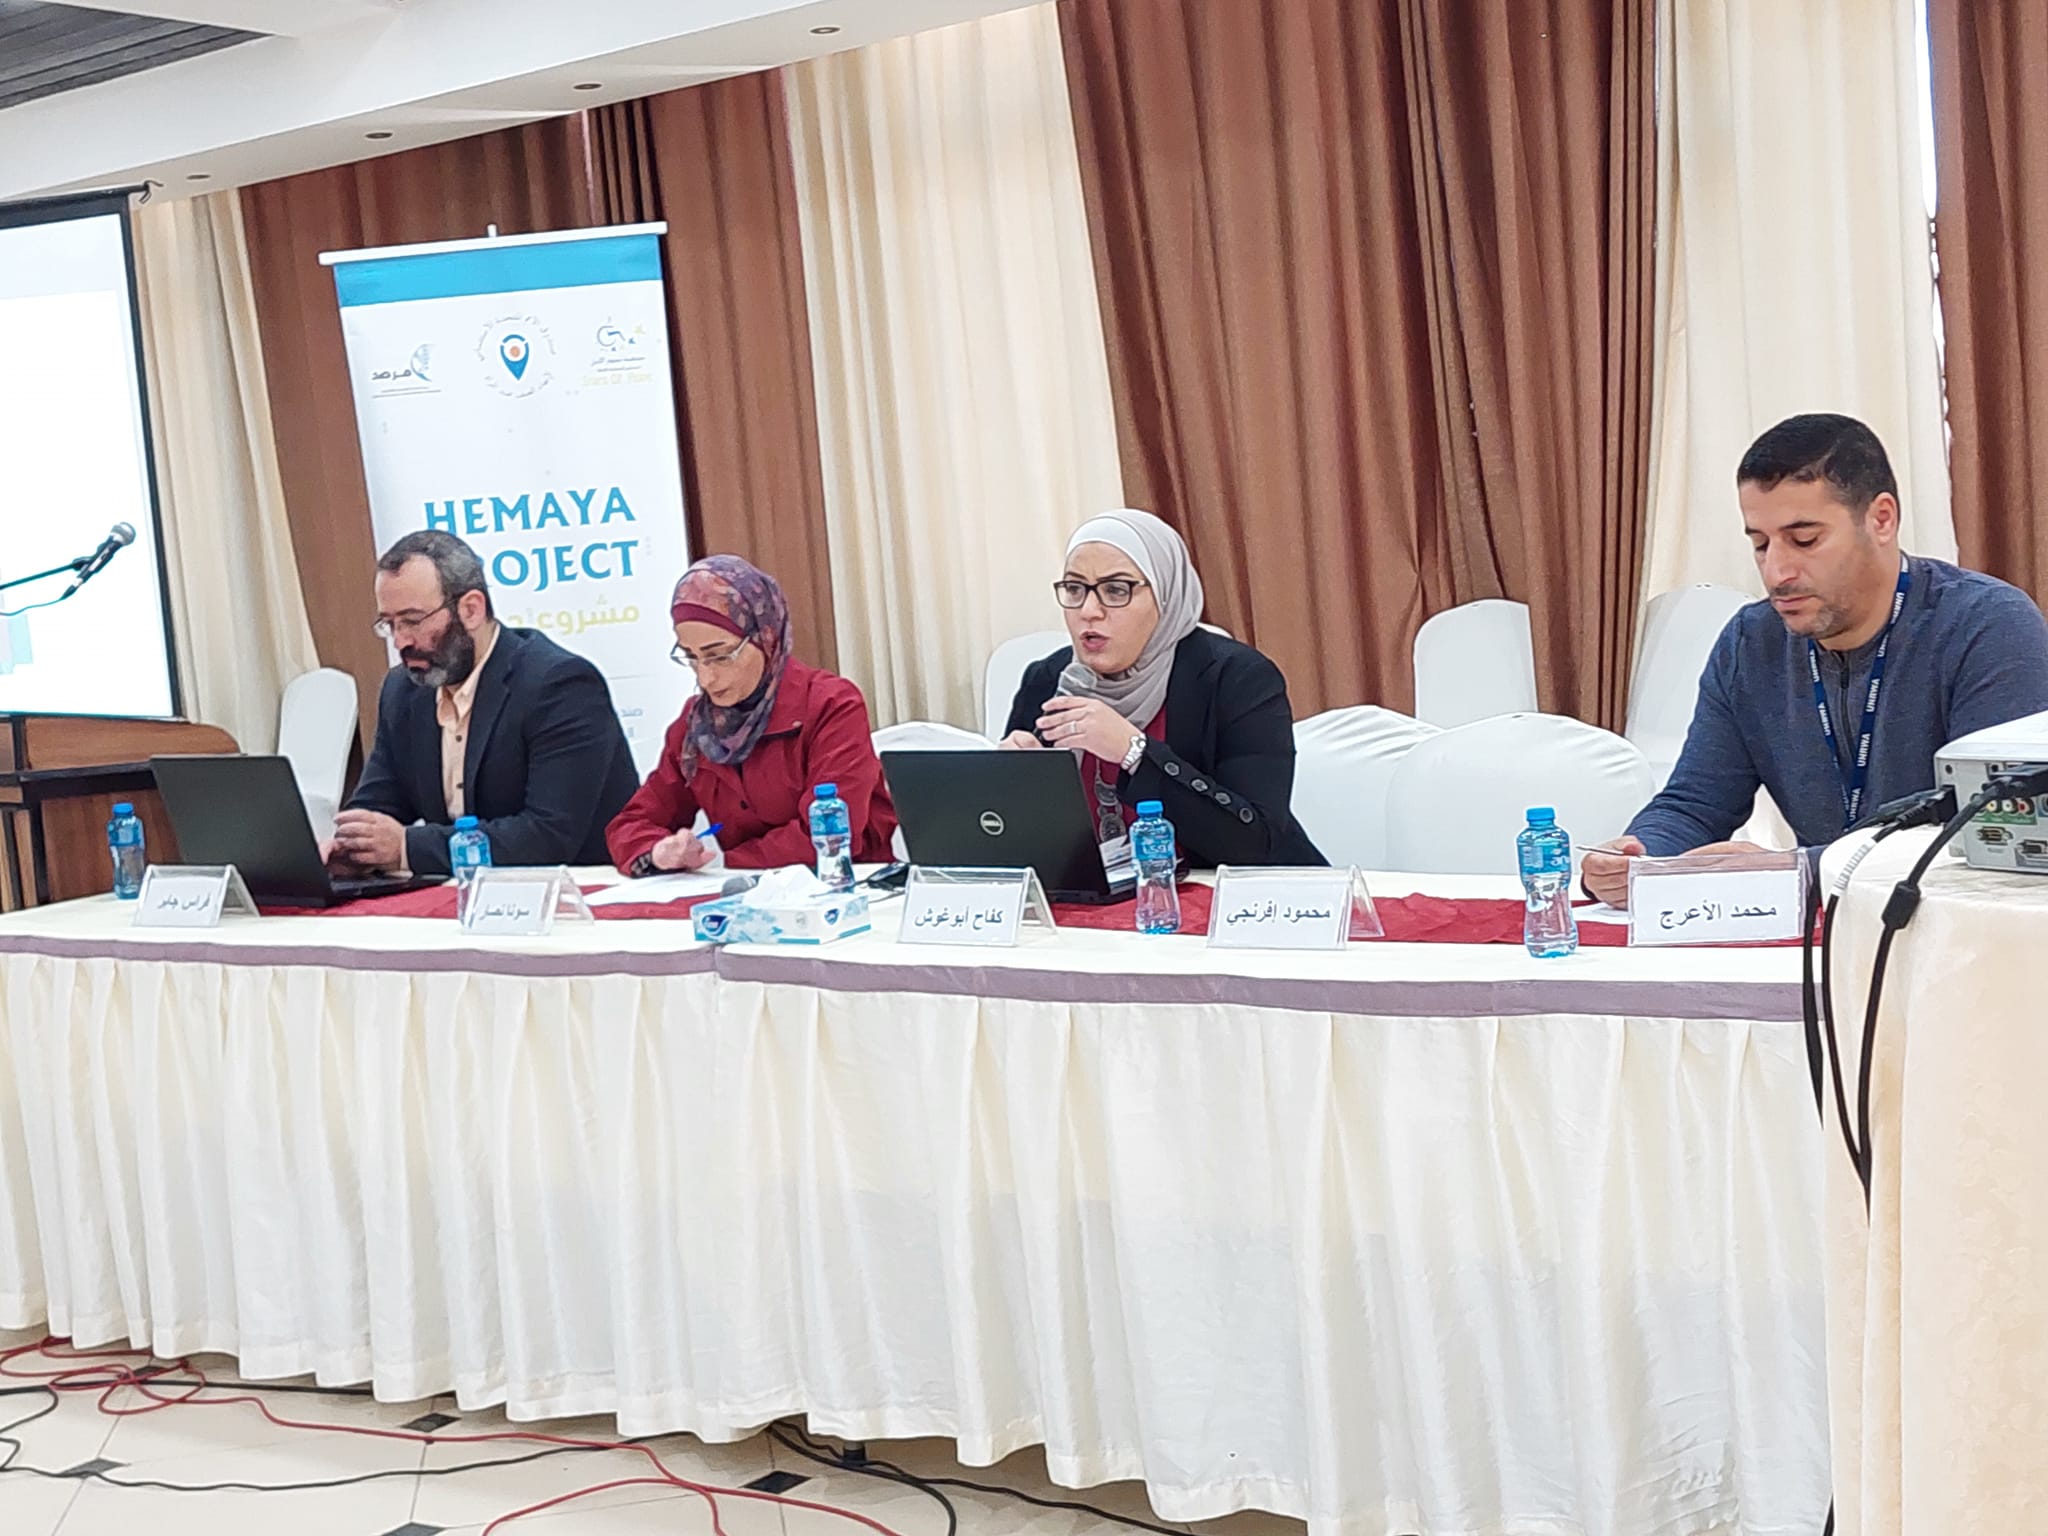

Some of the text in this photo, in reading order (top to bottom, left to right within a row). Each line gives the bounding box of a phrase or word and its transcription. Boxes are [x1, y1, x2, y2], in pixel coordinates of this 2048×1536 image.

[423, 486, 637, 536] HEMAYA
[478, 539, 639, 592] OJECT
[535, 594, 640, 636] مشروع
[1866, 678, 1880, 713] UNRWA
[1857, 733, 1870, 767] UNRWA
[1850, 787, 1861, 821] UNRWA
[973, 908, 1004, 930] كفاح
[1226, 900, 1331, 926] محمود إفرنجي
[1660, 899, 1777, 930] محمد الأعرج
